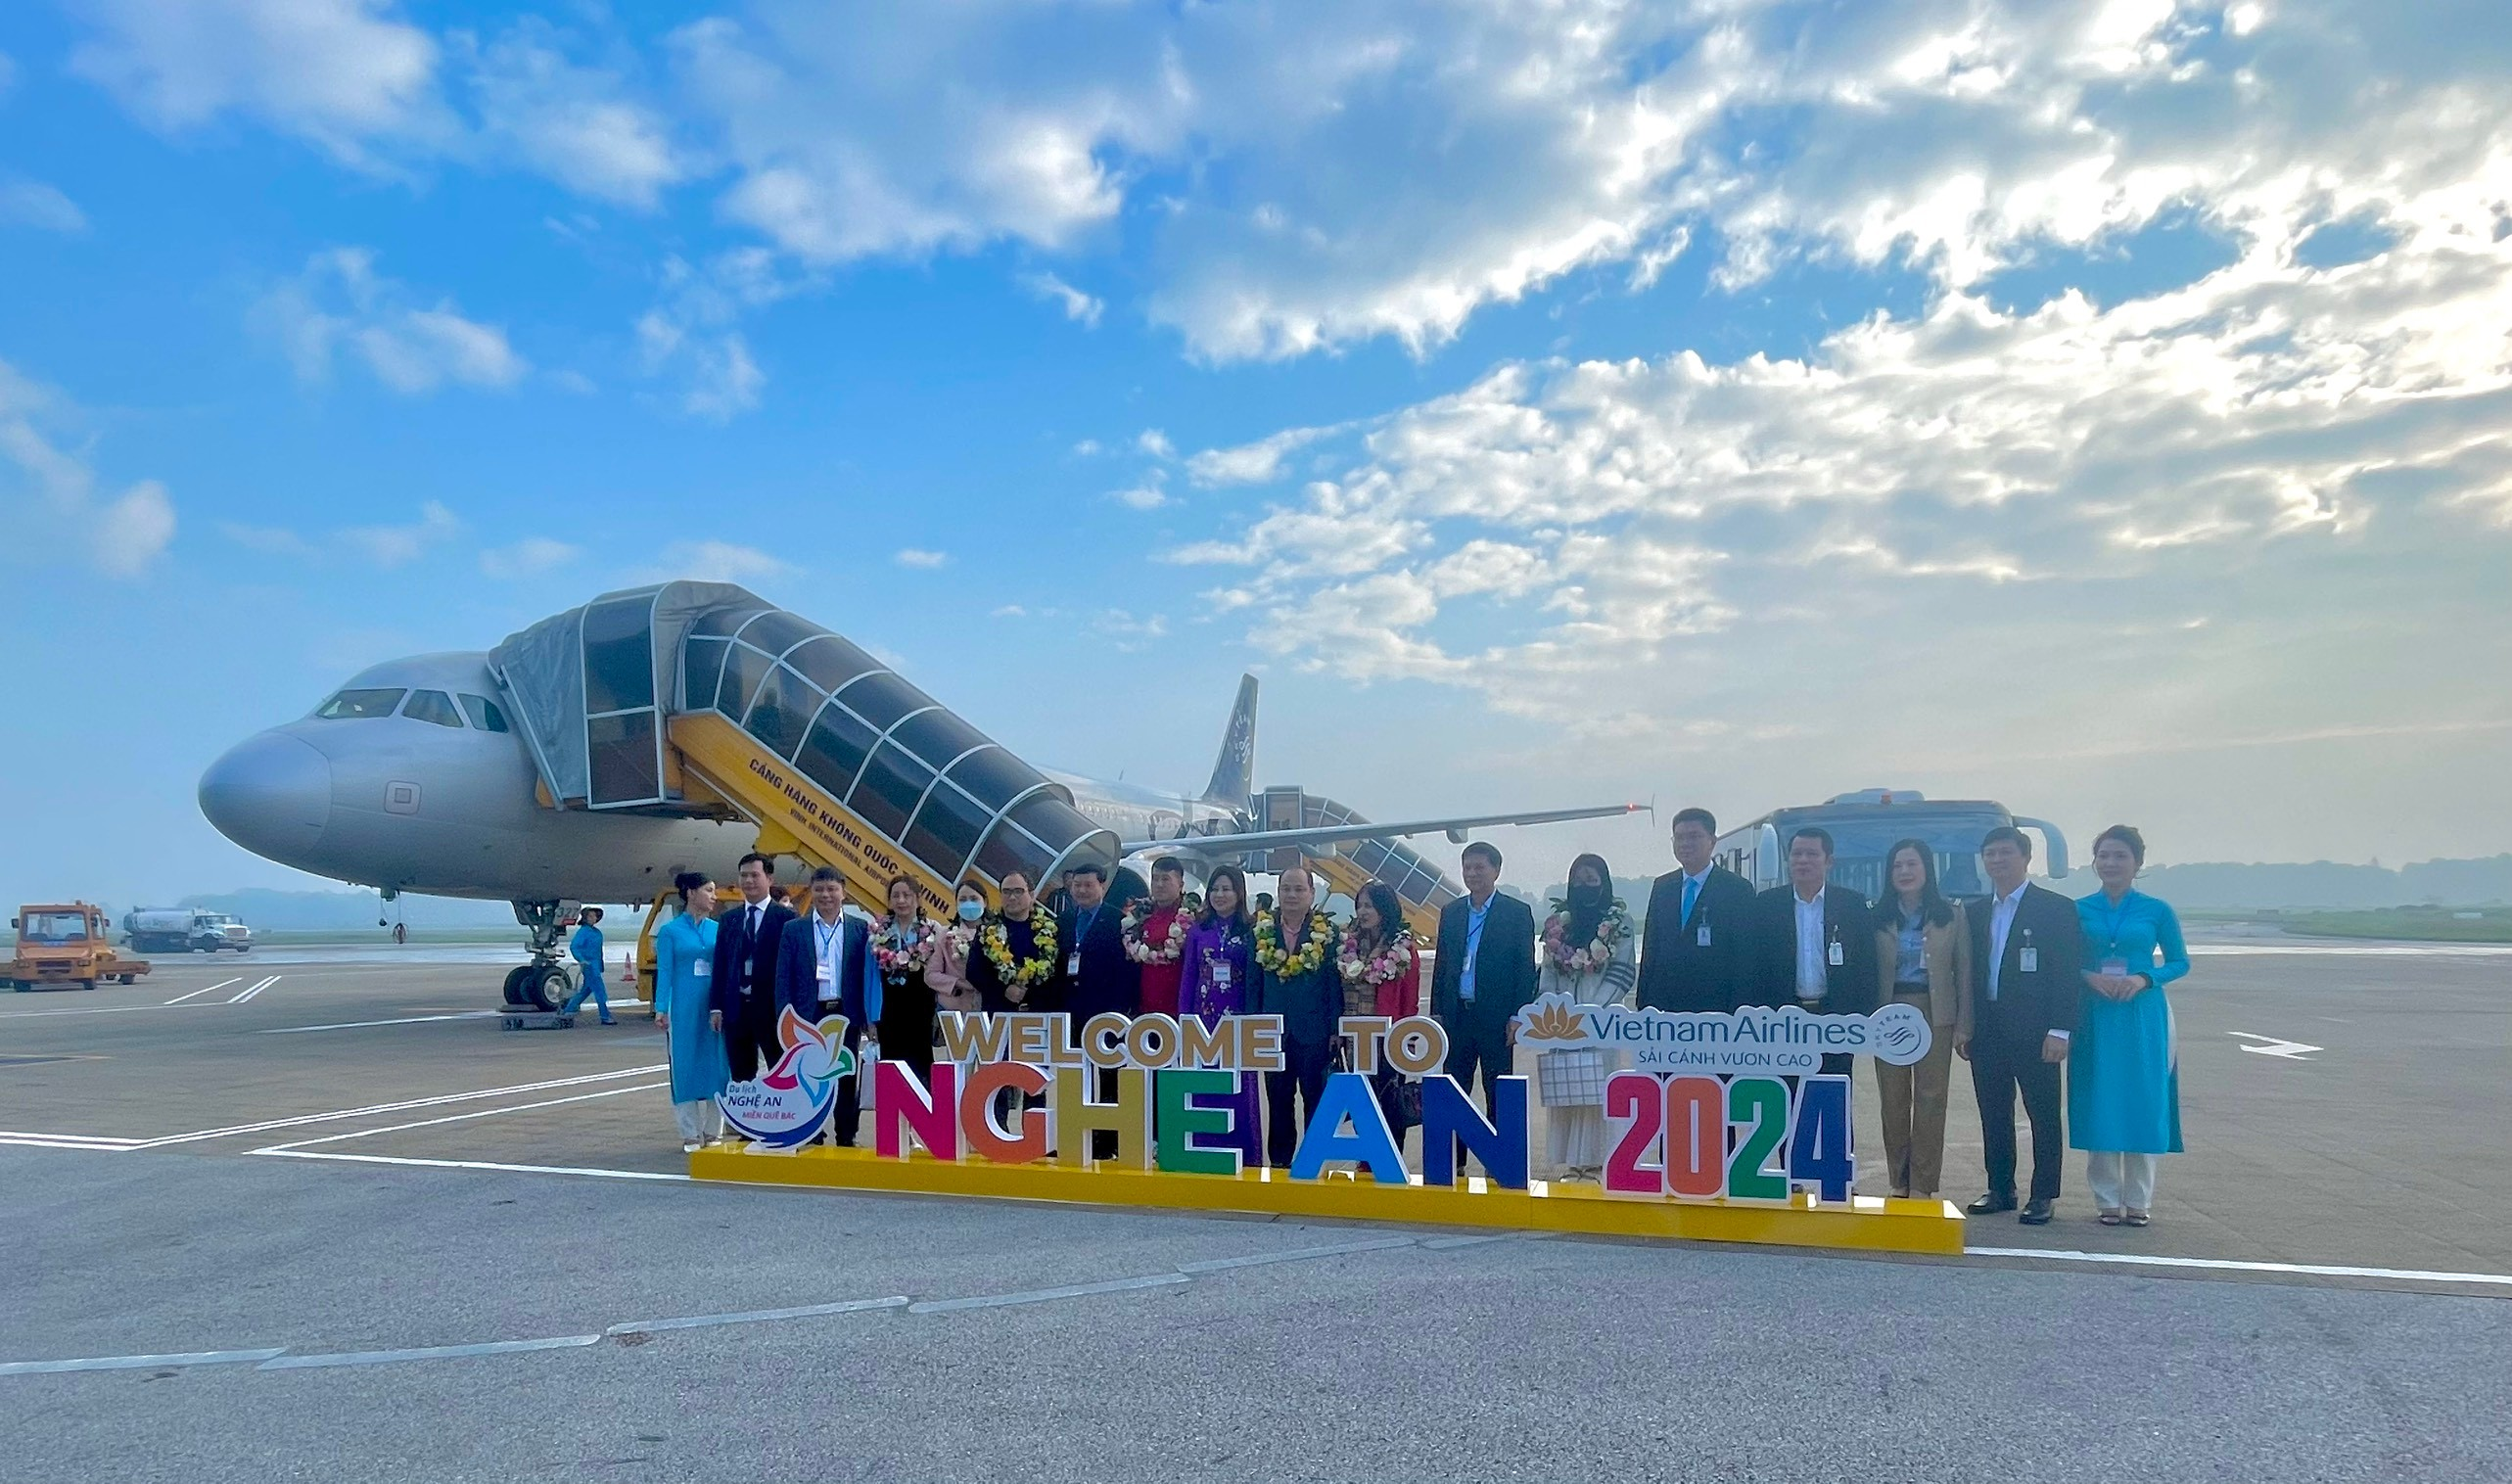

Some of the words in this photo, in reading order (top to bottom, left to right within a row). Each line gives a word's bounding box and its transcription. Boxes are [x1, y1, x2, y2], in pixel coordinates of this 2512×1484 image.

[809, 822, 861, 868] INTERNATIONAL
[818, 811, 861, 848] KHÔNG
[863, 844, 899, 875] QUỐC
[939, 1013, 1283, 1070] WELCOME
[1340, 1017, 1447, 1074] TO
[1591, 1014, 1729, 1044] Vietnam
[1733, 1015, 1866, 1044] Airlines
[1639, 1046, 1662, 1064] SẢI
[1667, 1048, 1715, 1065] CÁNH
[1776, 1053, 1813, 1067] CAO
[727, 1093, 762, 1108] NGHỆ
[764, 1096, 782, 1107] AN
[728, 1085, 740, 1093] Du
[876, 1060, 1243, 1175] NGHE
[1288, 1073, 1529, 1190] AN
[1605, 1073, 1853, 1202] 2024
